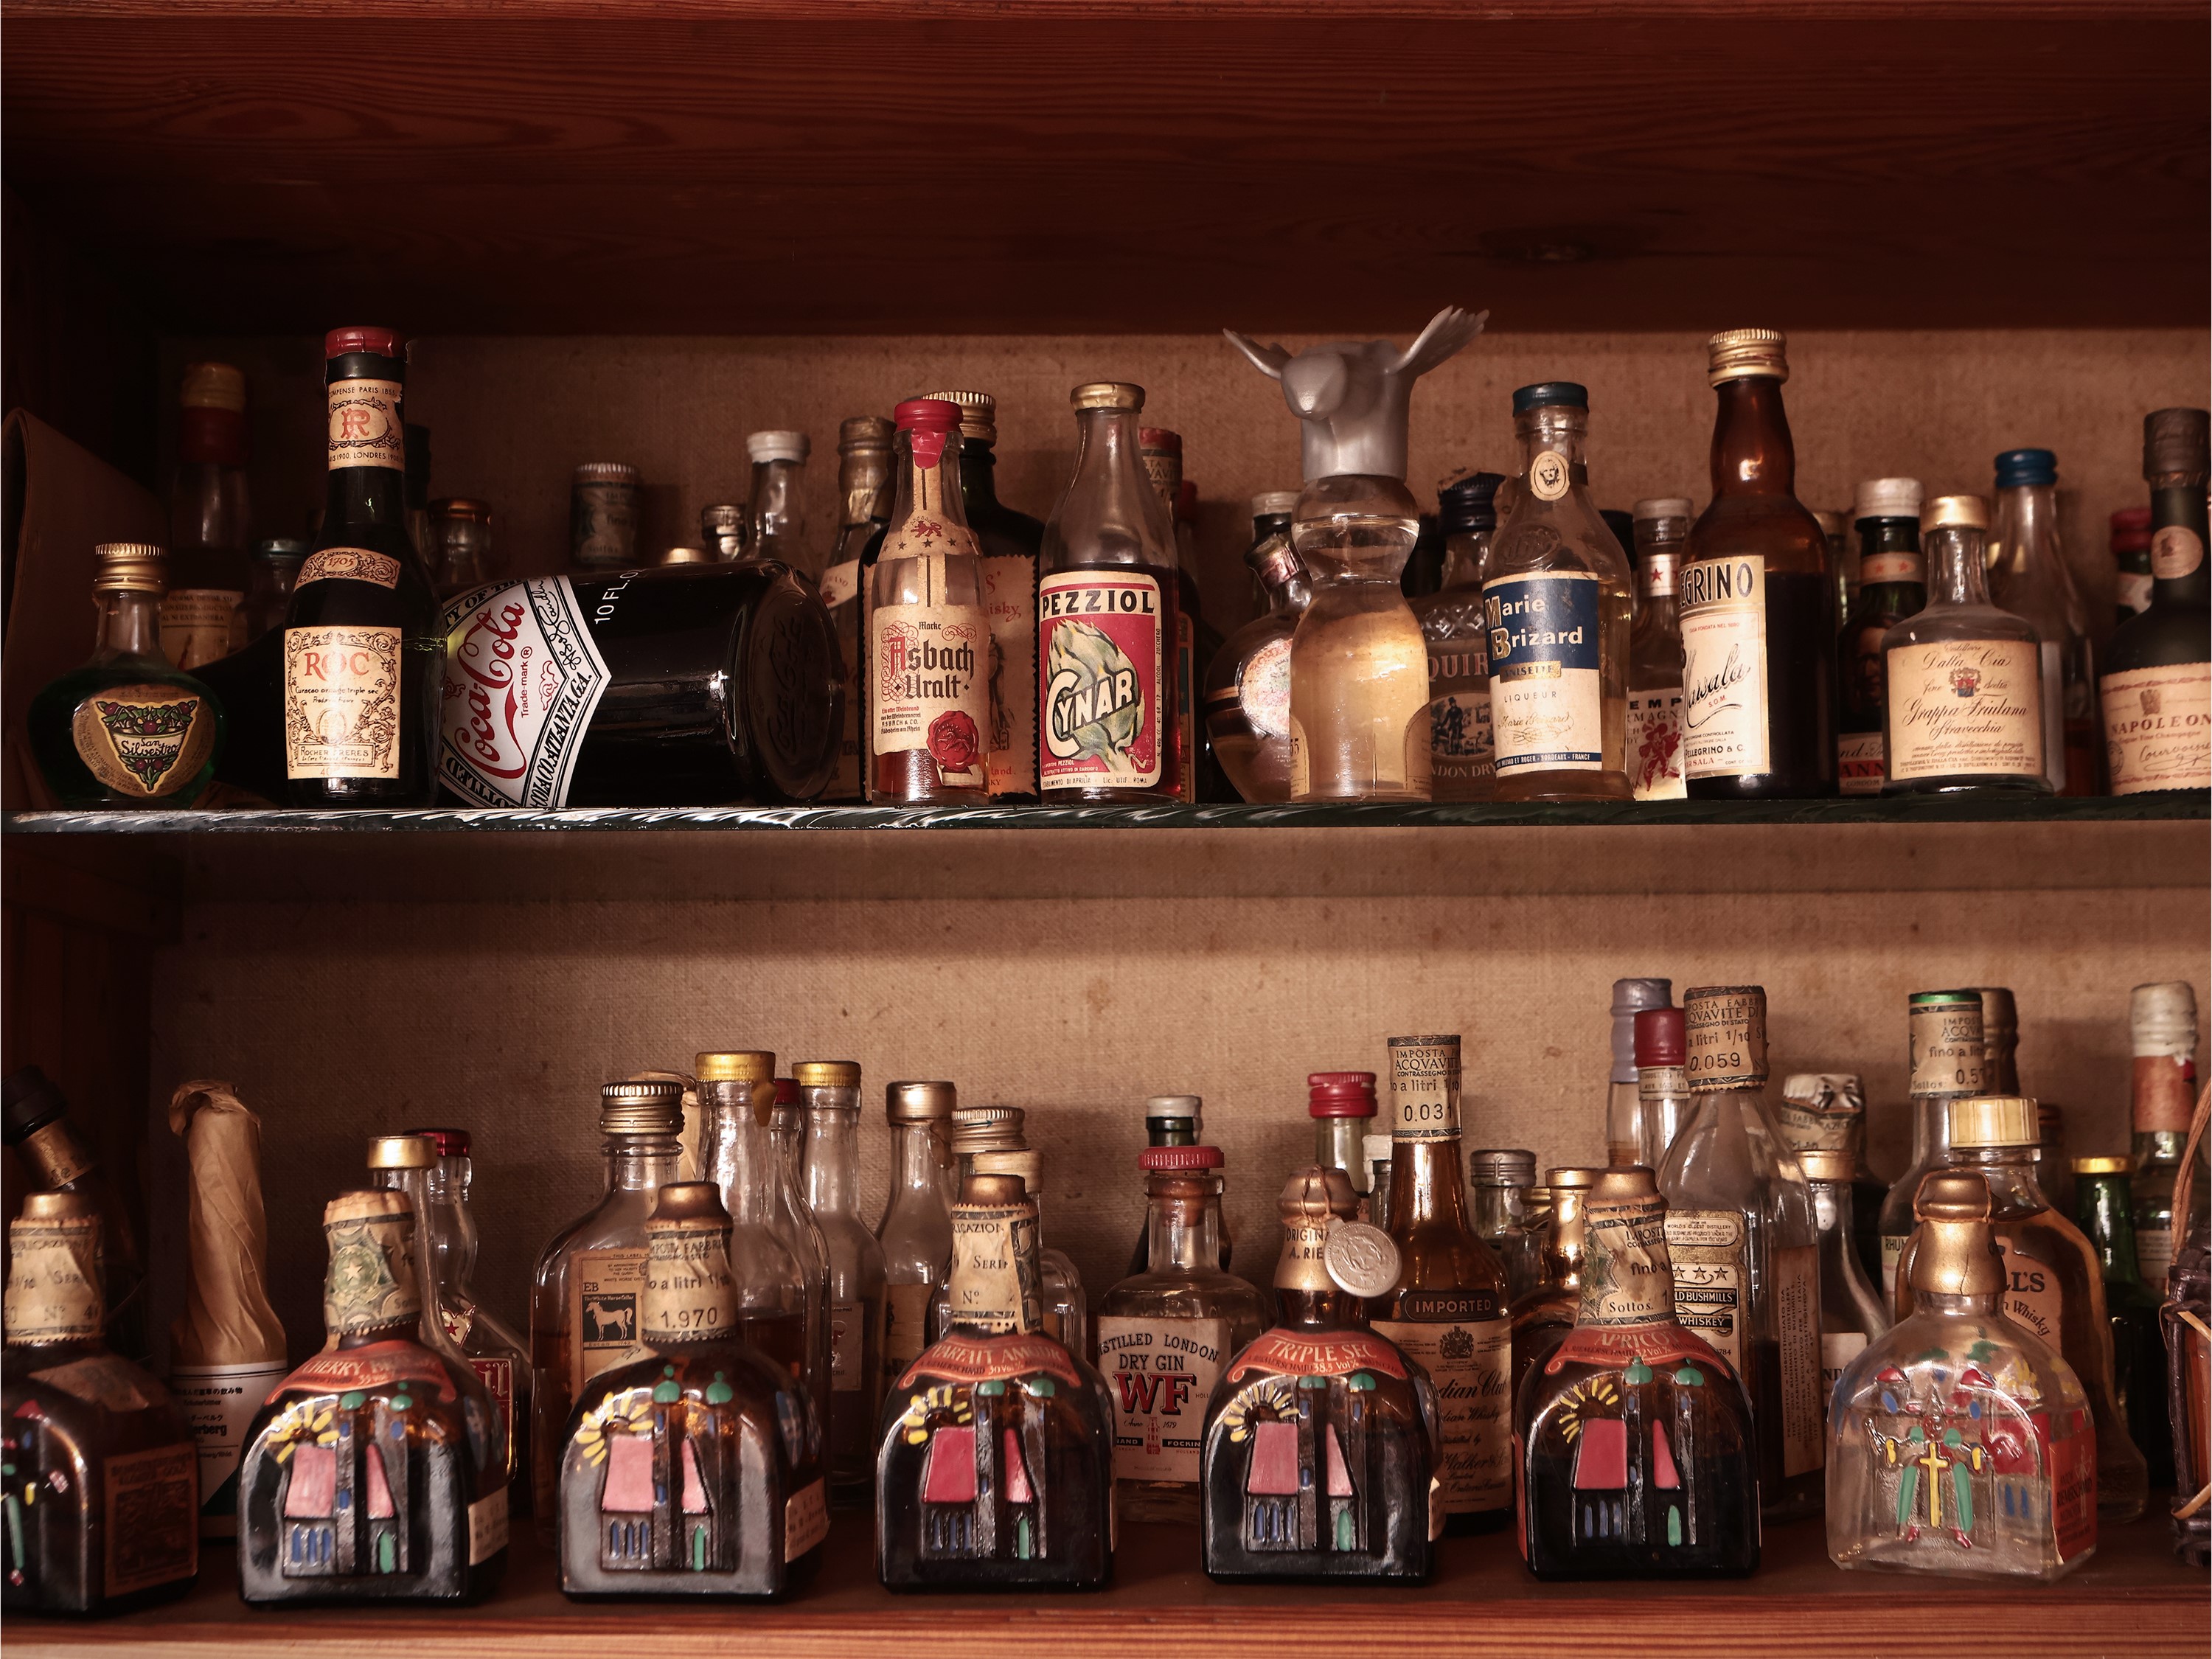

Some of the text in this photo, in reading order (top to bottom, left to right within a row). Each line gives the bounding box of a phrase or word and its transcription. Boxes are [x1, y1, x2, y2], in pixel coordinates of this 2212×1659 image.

[329, 557, 355, 567] 1705
[465, 589, 487, 608] OF
[594, 579, 631, 625] 10 FL.
[1042, 590, 1155, 619] PEZZIOL
[990, 601, 1022, 622] isky
[1485, 594, 1545, 630] Marie
[919, 622, 942, 630] Marke
[1491, 626, 1583, 661] Brizard
[305, 652, 369, 681] ROC
[887, 636, 975, 681] Asbach
[1922, 650, 2012, 670] Dalla Cia
[296, 686, 319, 695] Curaçao
[347, 686, 366, 695] triple
[454, 601, 526, 779] Coca-Cola
[521, 661, 529, 719] Trade-mark
[570, 672, 593, 698] GA.
[905, 674, 962, 699] Uralt
[1504, 691, 1557, 703] LIQUEUR
[1046, 668, 1138, 759] CYNAR
[1902, 693, 2028, 726] Grappa Friulana
[1929, 720, 2007, 741] Stravecchia
[2111, 714, 2211, 734] NAPOLEON
[121, 740, 179, 756] Silvestro
[141, 738, 160, 747] San
[301, 746, 329, 756] ROCHER
[1686, 745, 1723, 758] PELLEGRINO
[1520, 755, 1536, 763] ROGER
[1572, 753, 1590, 761] FRANCE
[445, 757, 514, 808] OTTLED
[1696, 1029, 1750, 1046] litri 1/10
[1397, 1049, 1445, 1058] IMPOSTA
[1929, 1046, 1954, 1057] fino
[1690, 1052, 1740, 1071] 0.059
[1411, 1079, 1436, 1091] litri
[1404, 1103, 1452, 1121] 0.031
[1631, 1261, 1658, 1275] fino
[583, 1281, 599, 1292] EB
[674, 1276, 702, 1290] litri
[2006, 1270, 2045, 1293] L'S
[1415, 1298, 1492, 1313] IMPORTED
[1609, 1299, 1654, 1312] Sottos.
[1686, 1292, 1733, 1303] BUSHMILLS
[661, 1307, 717, 1328] 1.970
[1679, 1317, 1725, 1326] WHISKEY
[2013, 1298, 2051, 1338] Whisky
[1164, 1334, 1219, 1363] LONDON
[1593, 1330, 1680, 1349] APRICOT
[1267, 1339, 1338, 1363] TRIPLE
[1341, 1343, 1377, 1359] SEC
[1119, 1354, 1184, 1371] DRY GIN
[1113, 1371, 1197, 1415] WF
[1124, 1417, 1178, 1429] Anno 1679
[1467, 1405, 1500, 1425] Whisky
[1445, 1452, 1489, 1471] Walker
